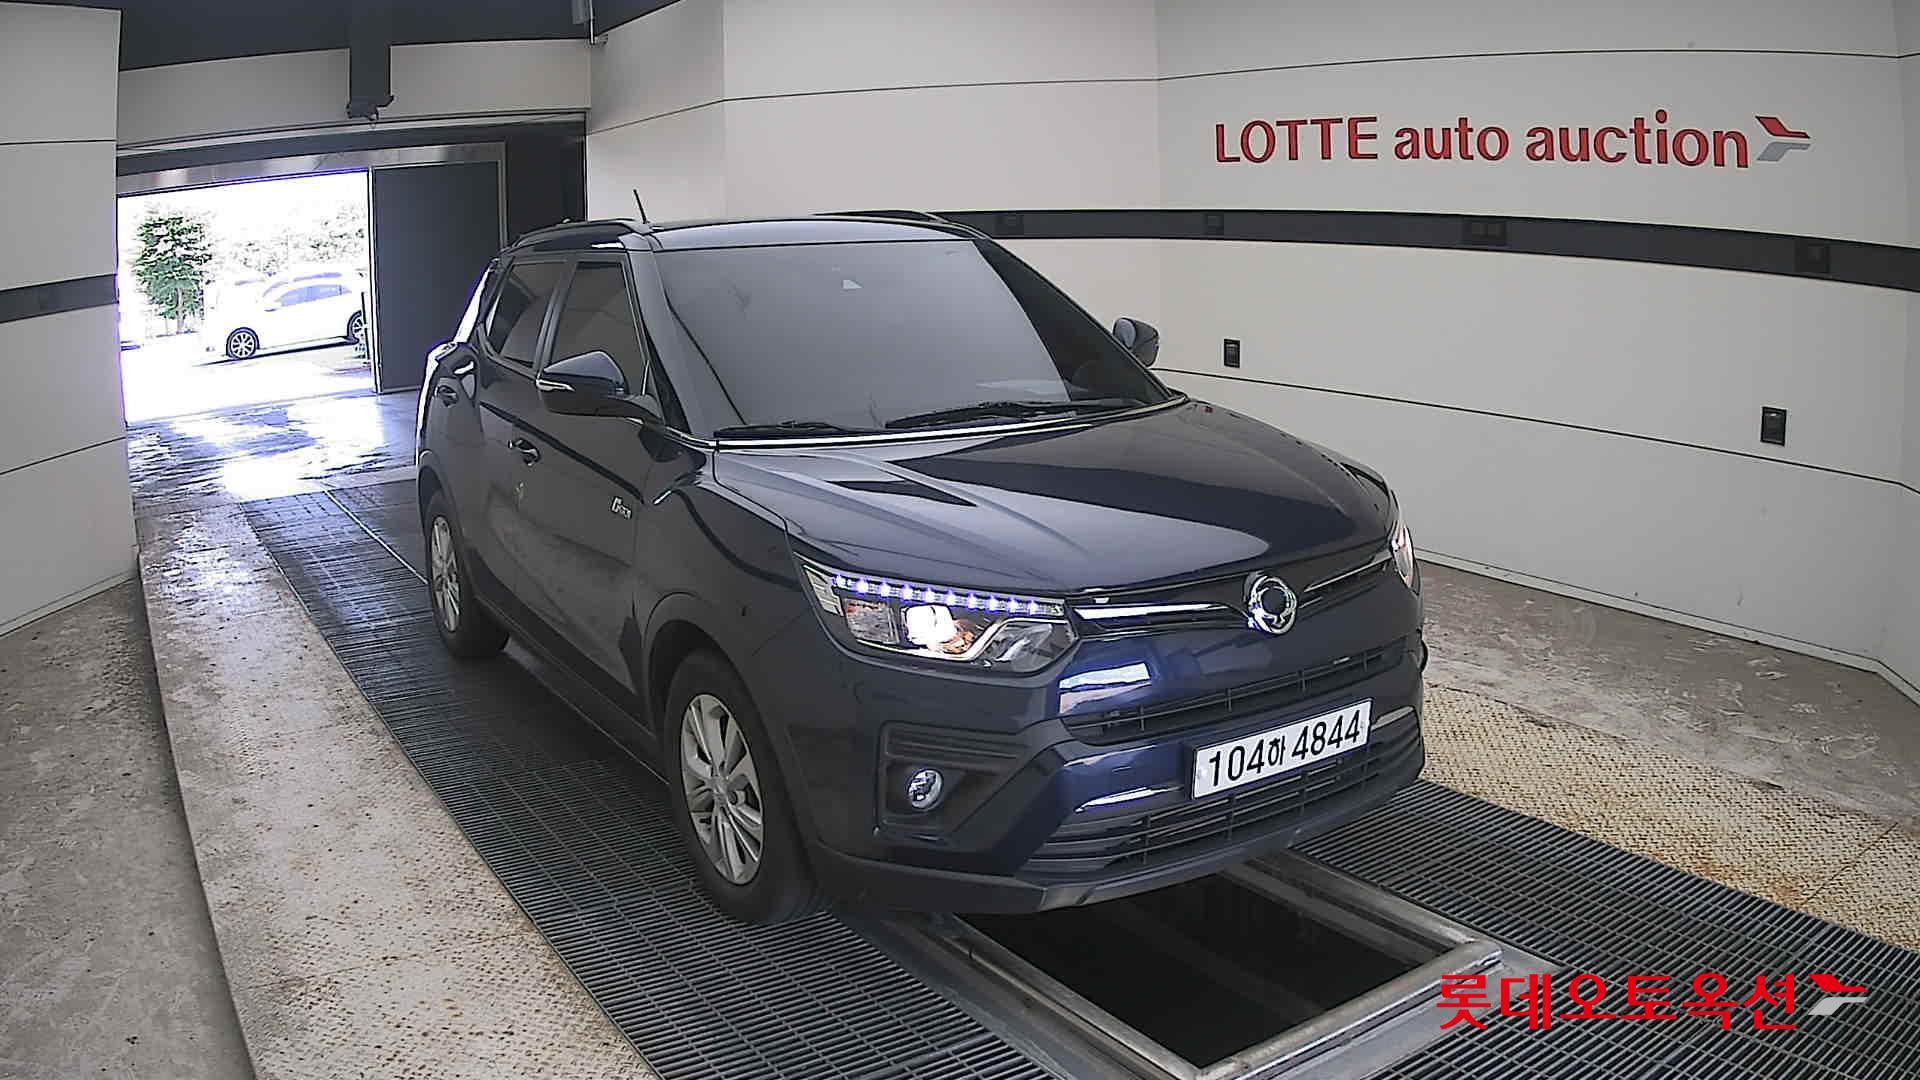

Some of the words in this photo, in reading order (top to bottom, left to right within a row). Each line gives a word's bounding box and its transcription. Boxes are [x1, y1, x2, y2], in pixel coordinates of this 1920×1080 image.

[1215, 116, 1378, 163] LOTTE
[1394, 116, 1510, 162] auto
[1525, 109, 1750, 169] auction
[1209, 735, 1285, 787] 104하
[1292, 709, 1360, 760] 4844
